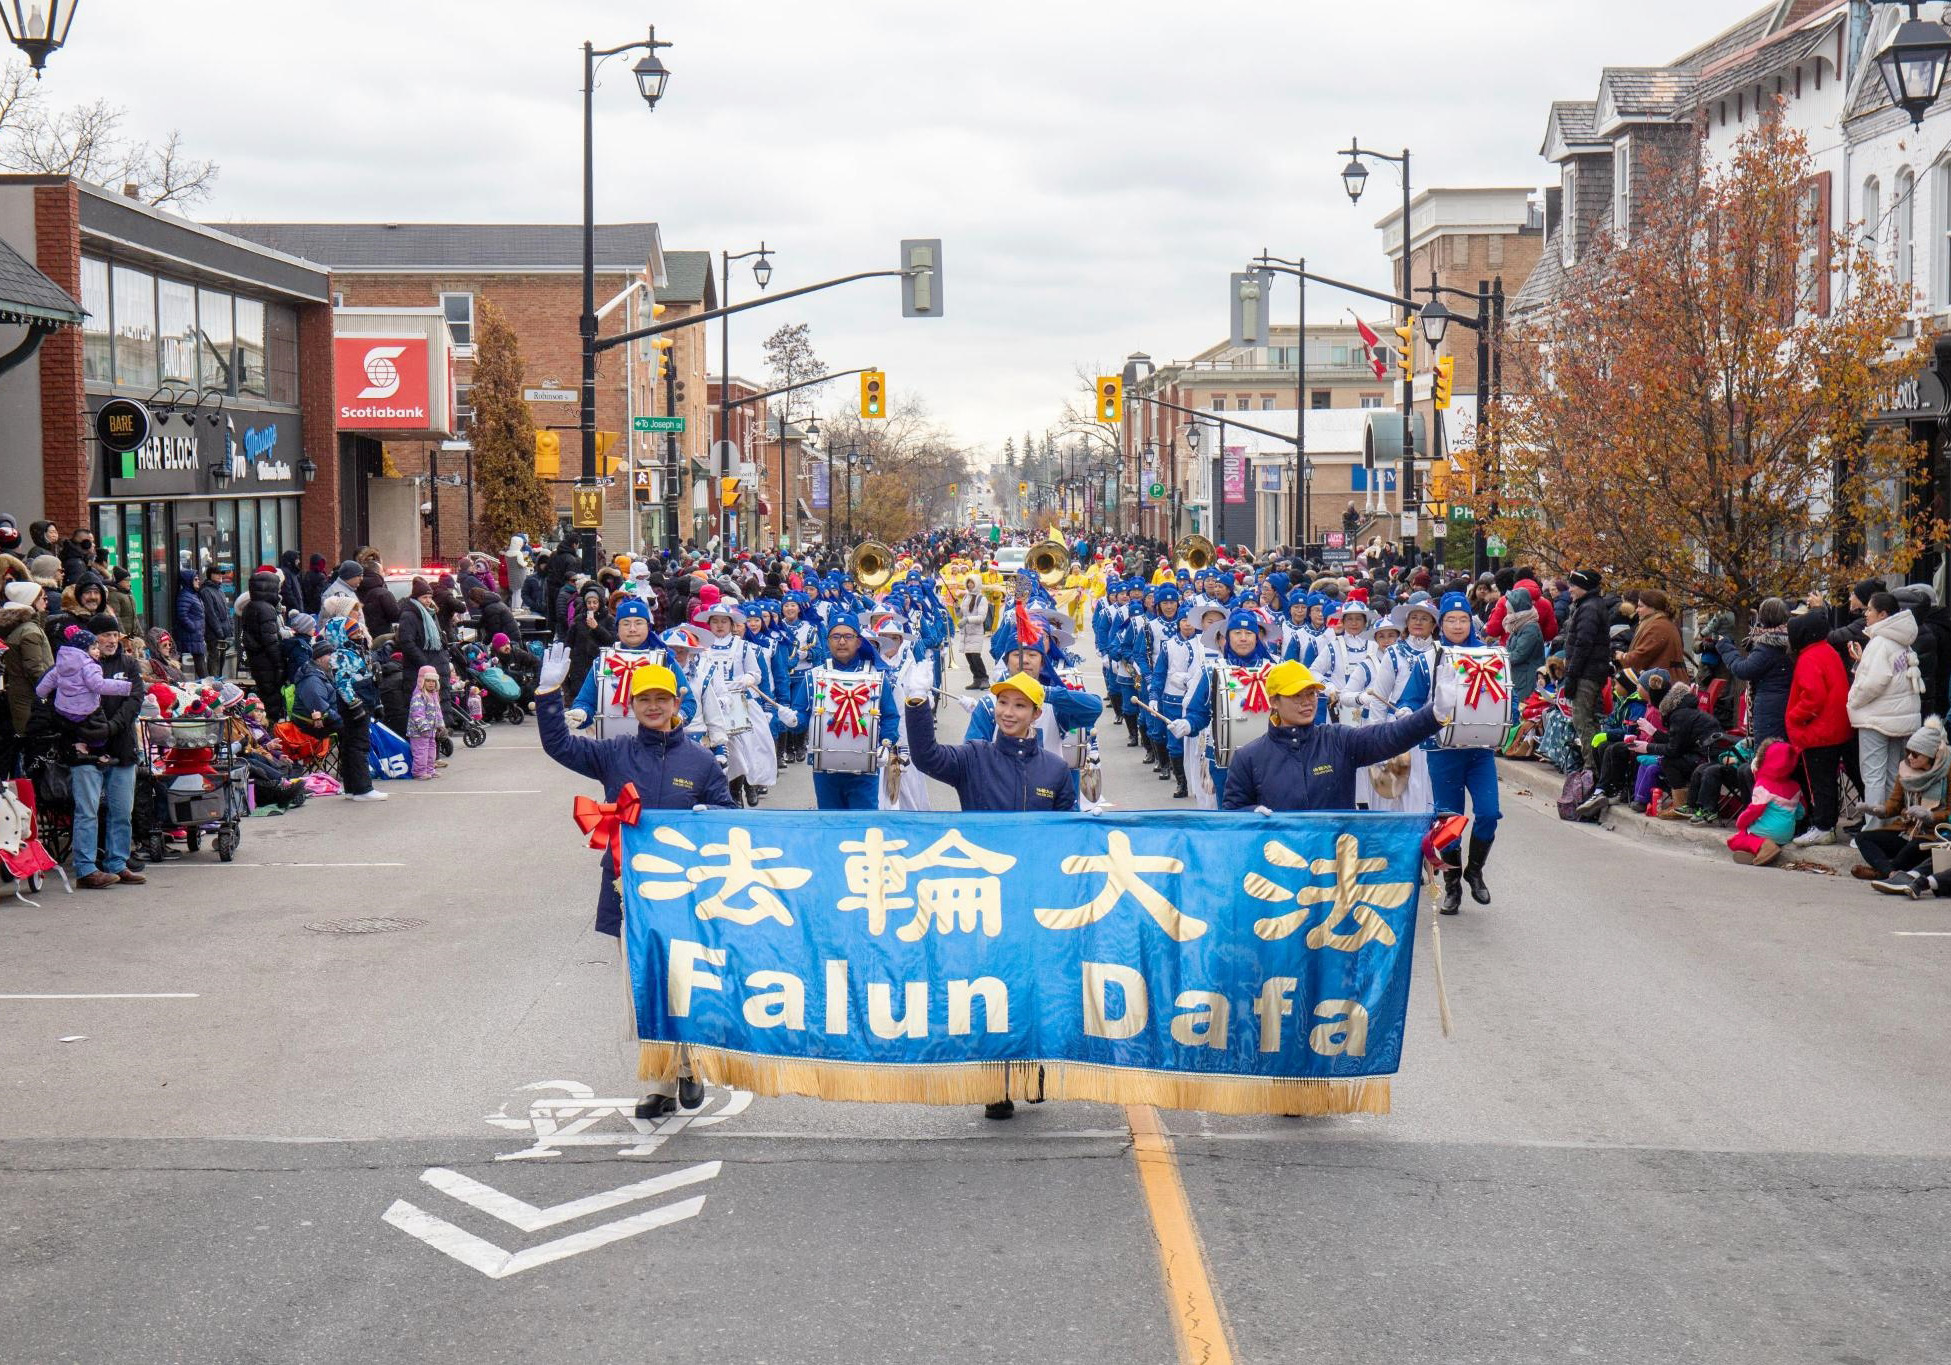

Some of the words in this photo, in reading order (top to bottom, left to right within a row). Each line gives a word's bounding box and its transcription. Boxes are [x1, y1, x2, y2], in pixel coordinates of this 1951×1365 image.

[533, 391, 563, 400] Robinson
[109, 415, 134, 432] BARE
[341, 406, 424, 418] Scotiabank
[641, 420, 649, 428] To
[650, 420, 675, 430] Joseph
[138, 436, 161, 470] H&R
[164, 436, 199, 470] BLOCK
[1224, 451, 1240, 482] SHOP
[631, 826, 1414, 952] 法輪大法
[667, 938, 1009, 1040] Falun
[1082, 961, 1370, 1057] Dafa
